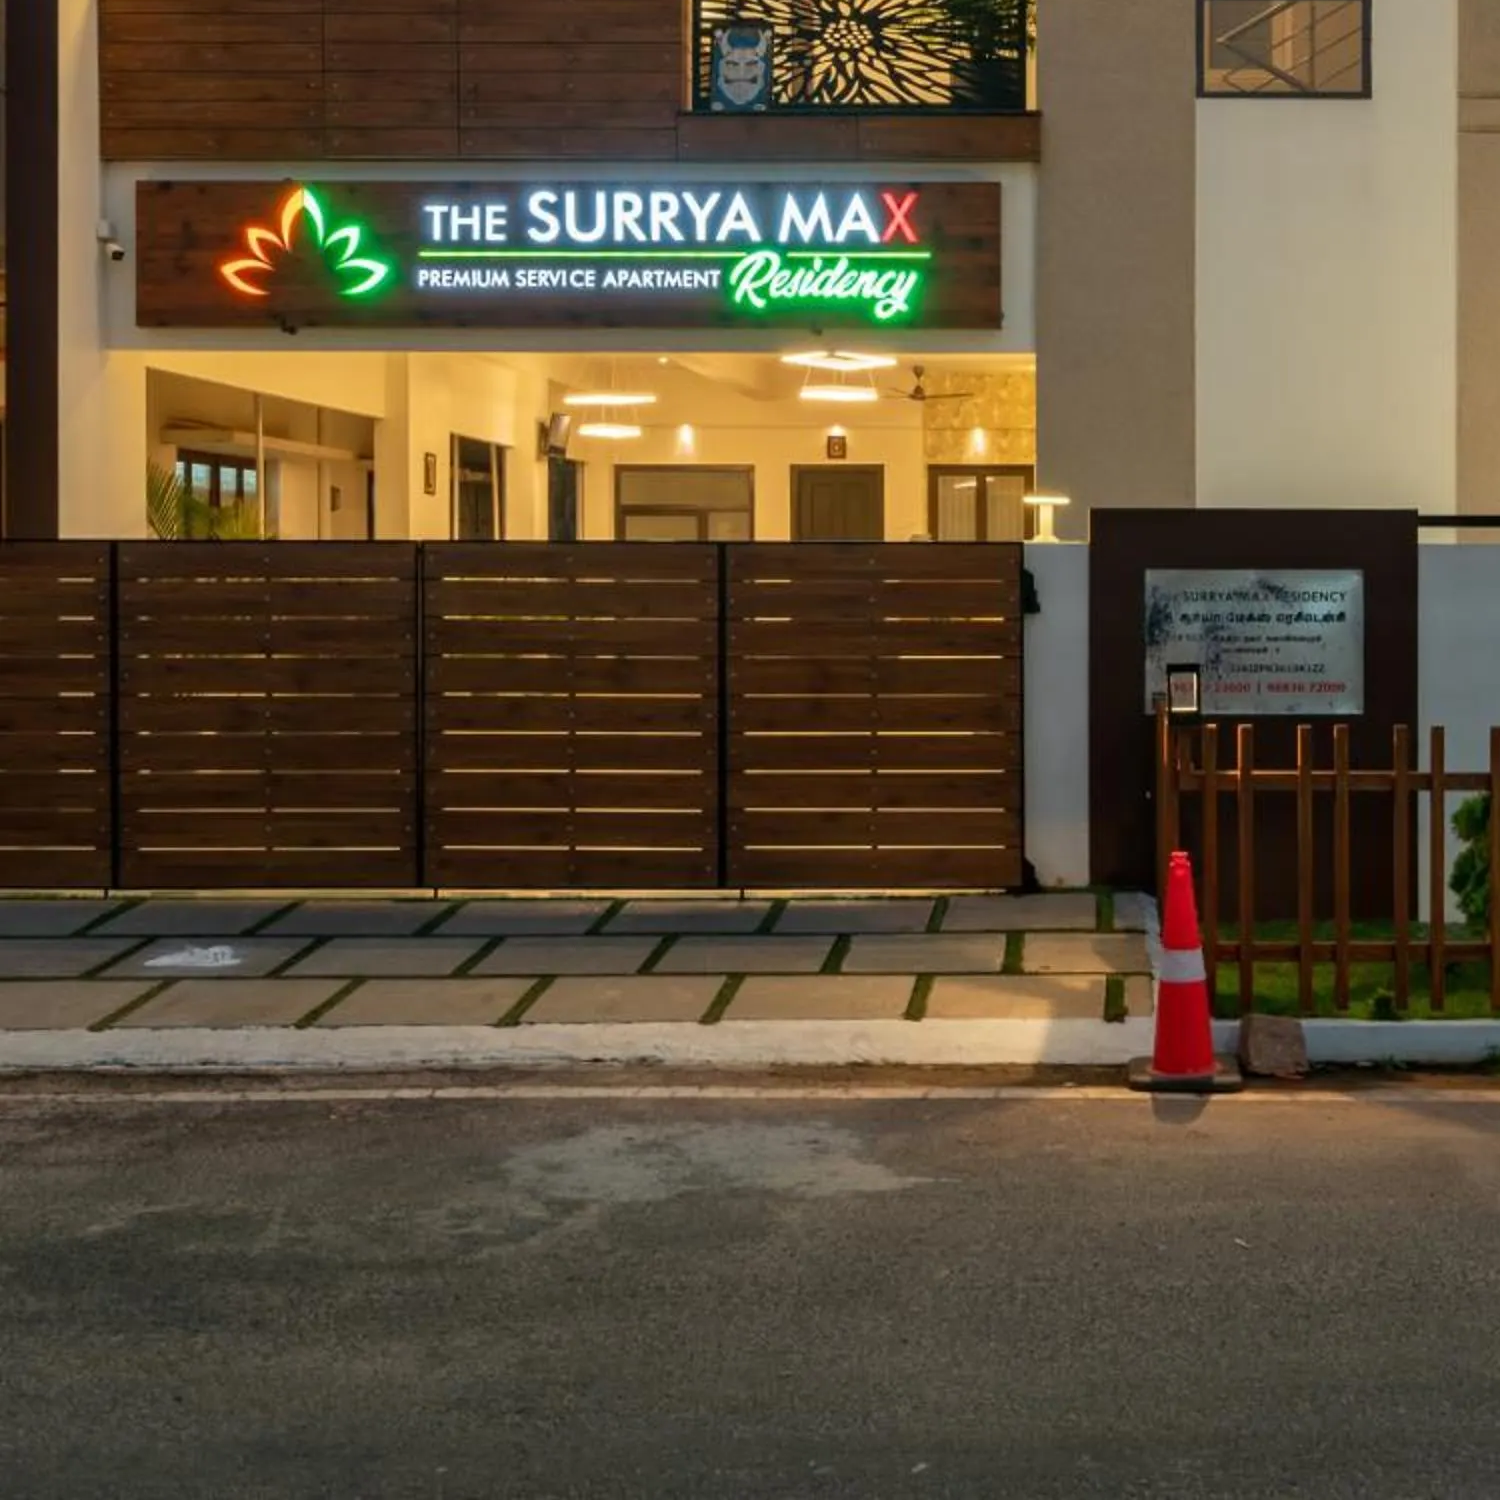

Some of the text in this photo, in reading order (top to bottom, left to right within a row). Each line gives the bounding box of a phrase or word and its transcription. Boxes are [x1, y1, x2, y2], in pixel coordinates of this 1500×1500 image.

[424, 190, 919, 242] THE SURRYA MAX
[417, 269, 721, 288] PREMIUM SERVICE APARTMENT
[729, 250, 918, 319] Residency
